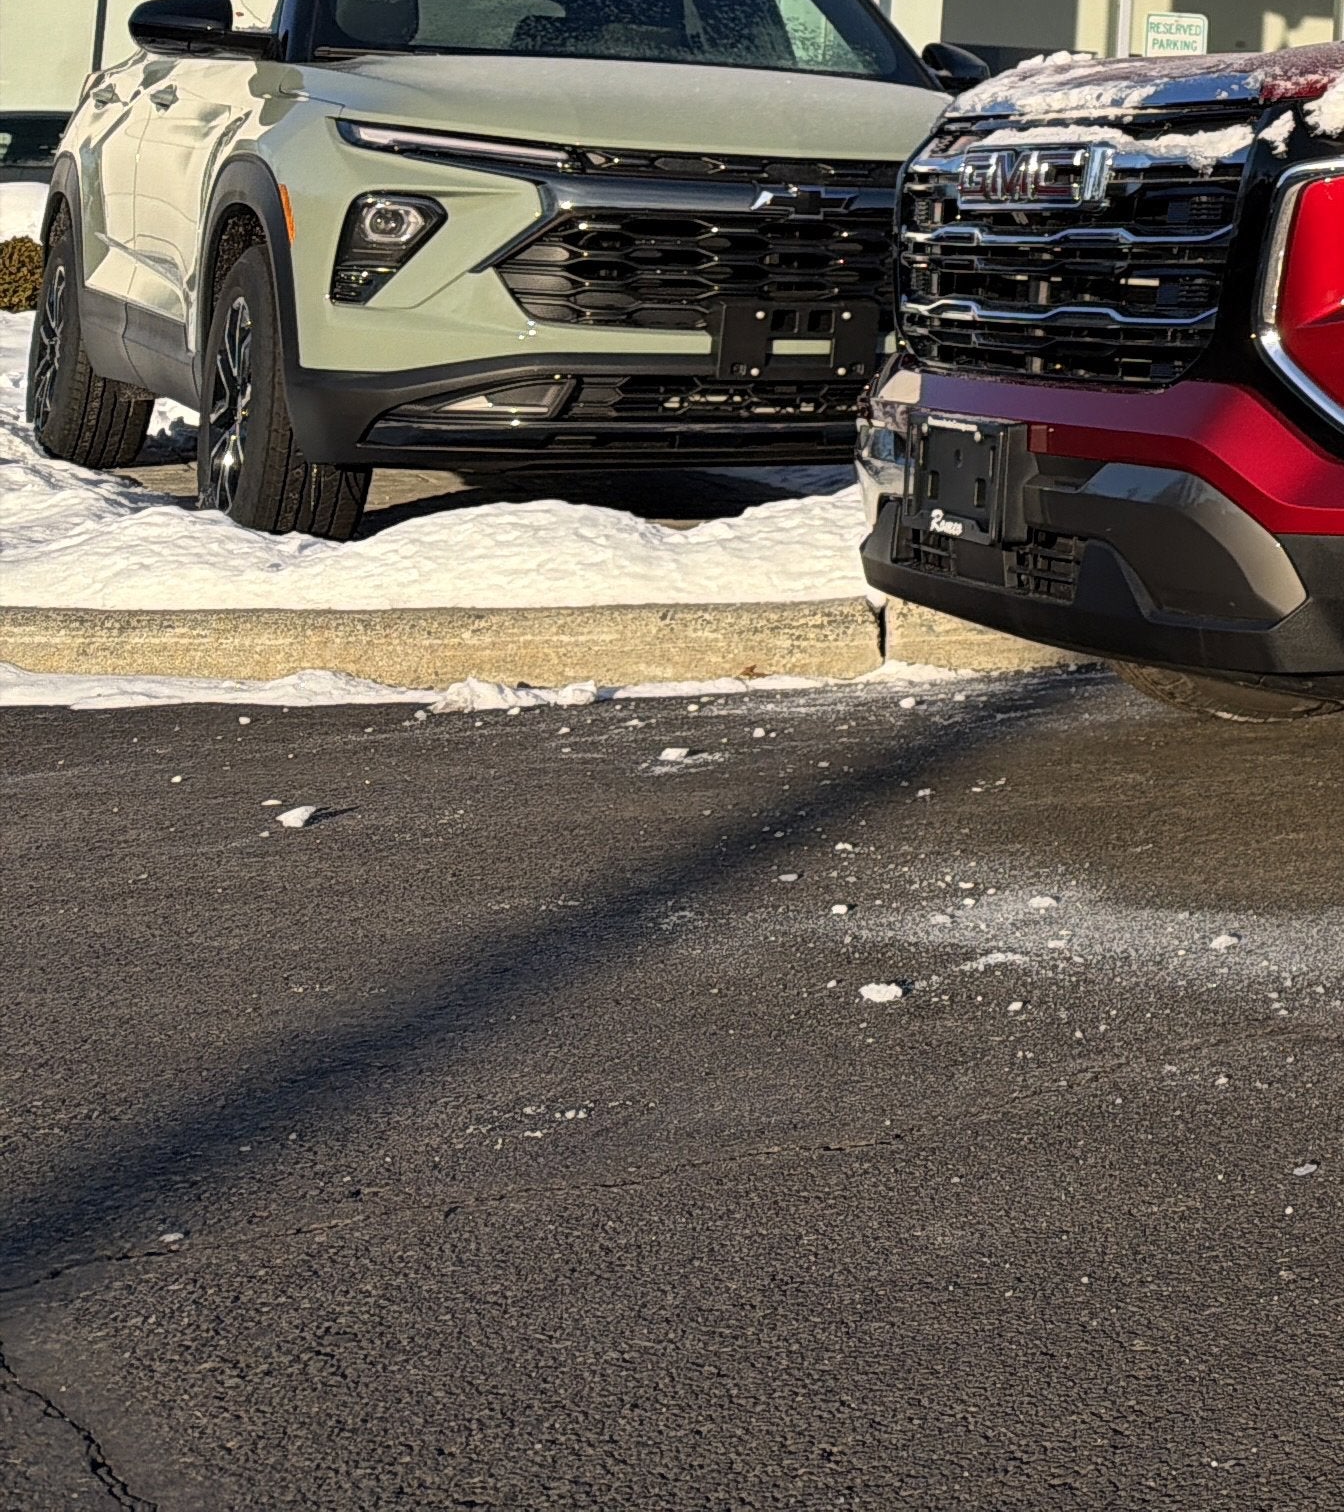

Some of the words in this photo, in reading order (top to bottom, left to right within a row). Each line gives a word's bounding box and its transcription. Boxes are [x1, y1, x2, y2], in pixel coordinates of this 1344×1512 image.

[1148, 22, 1201, 36] RESERVED
[1151, 38, 1198, 52] PARKING
[960, 150, 1086, 202] GMC
[930, 508, 963, 536] Romeo
